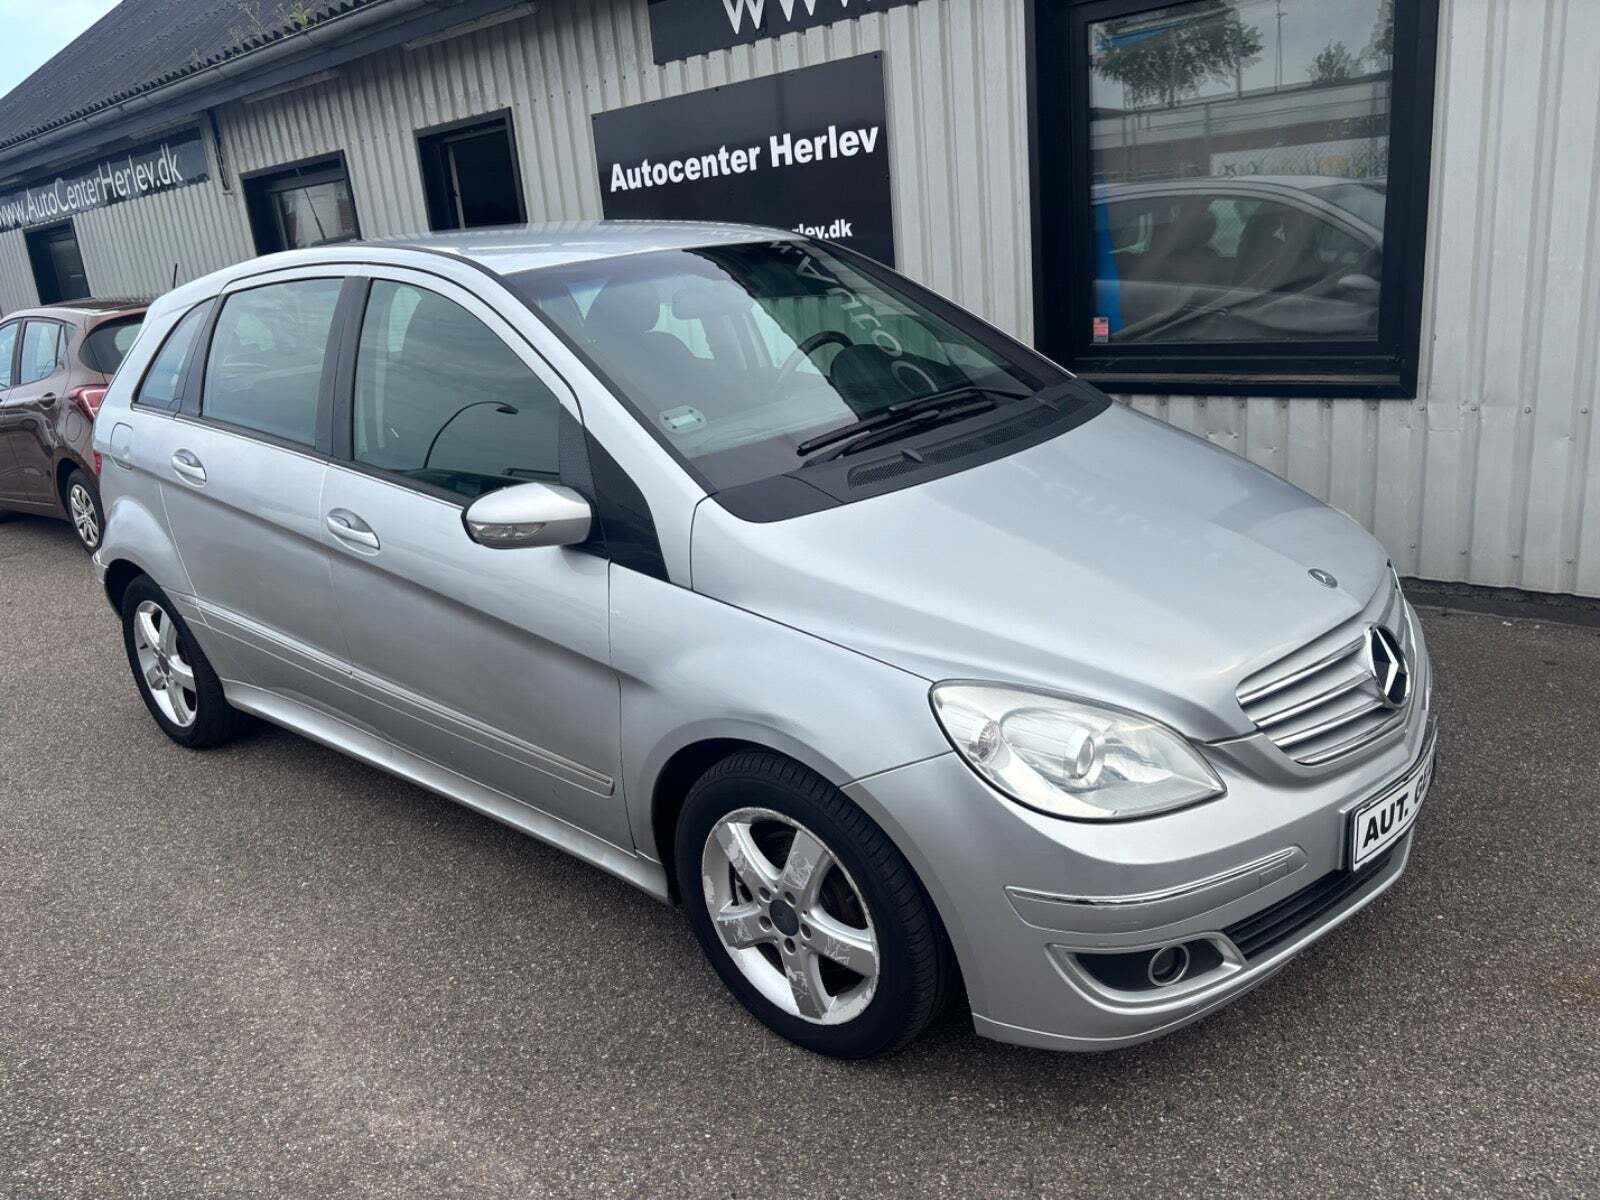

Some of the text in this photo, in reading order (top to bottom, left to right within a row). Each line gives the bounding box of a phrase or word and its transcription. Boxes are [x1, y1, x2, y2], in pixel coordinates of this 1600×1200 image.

[610, 125, 879, 192] Autocenter Herlev
[792, 218, 853, 239] lev.dk
[1362, 791, 1409, 849] AUT.
